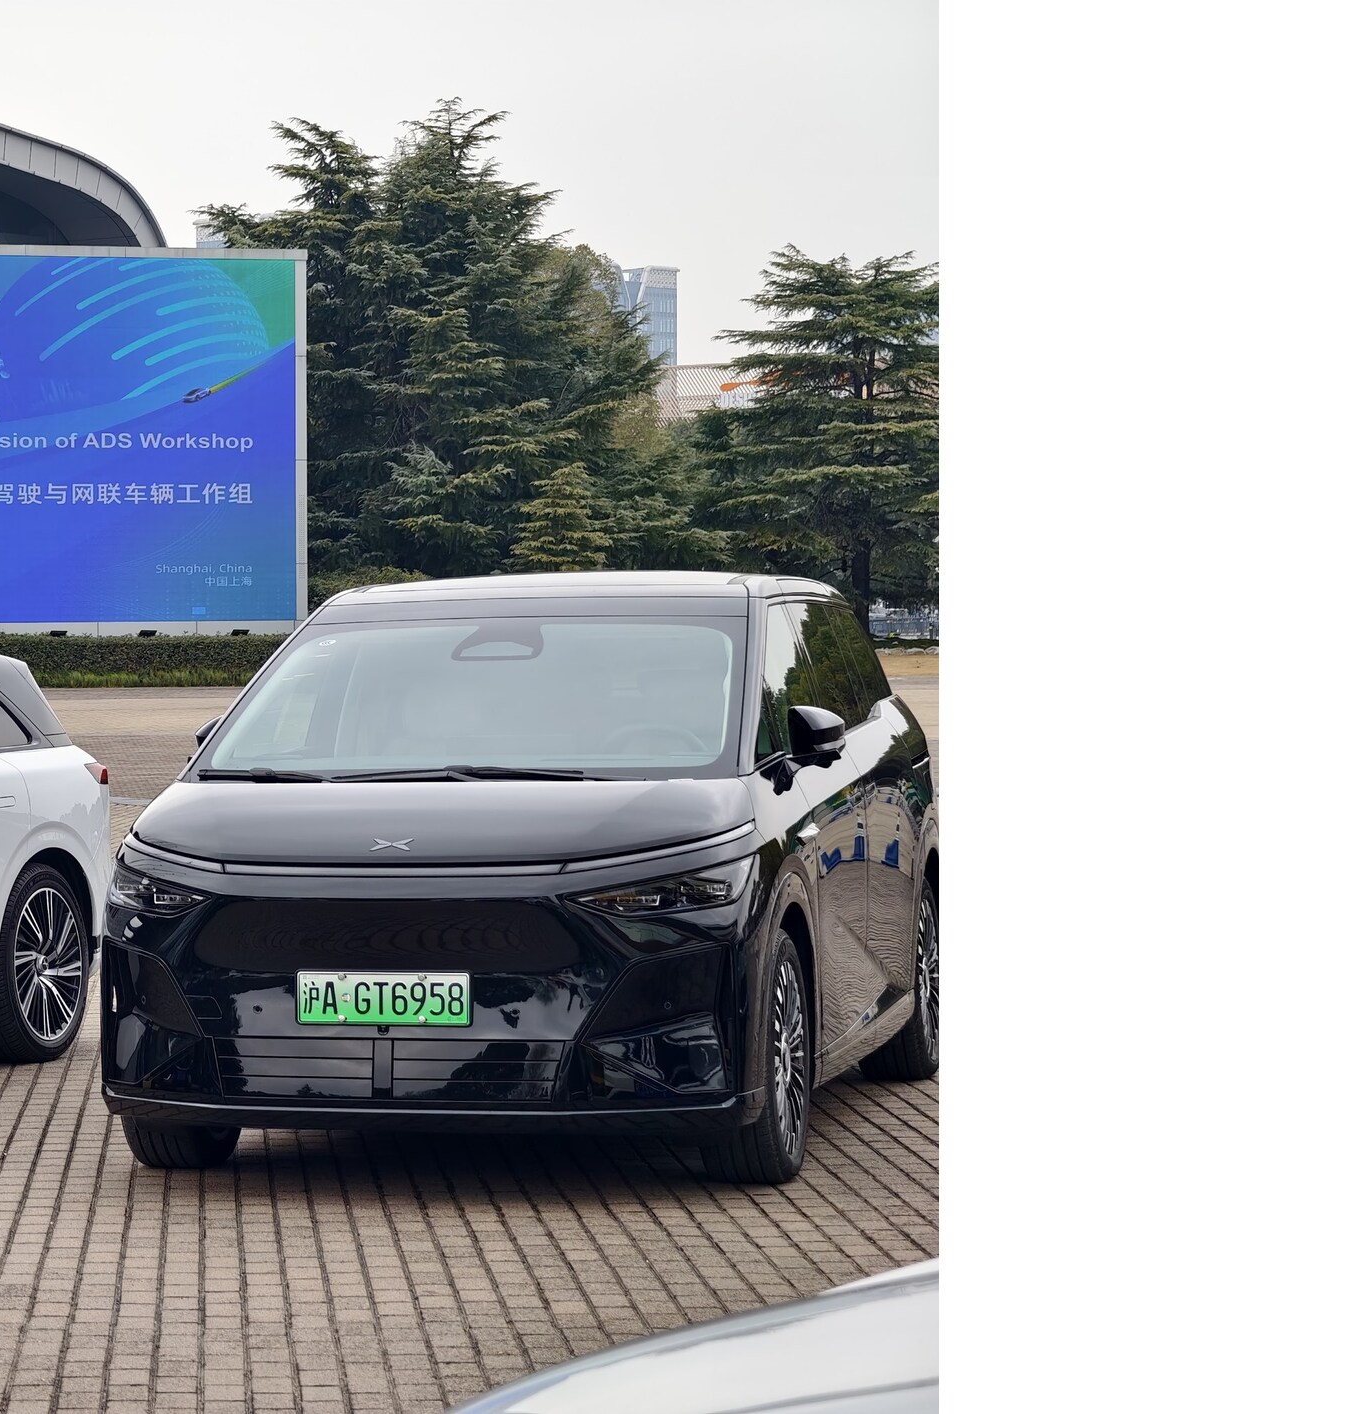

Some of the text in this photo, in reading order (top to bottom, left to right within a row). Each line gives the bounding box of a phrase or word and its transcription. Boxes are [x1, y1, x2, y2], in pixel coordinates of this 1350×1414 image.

[54, 431, 79, 449] of
[82, 432, 133, 449] ADS
[139, 432, 254, 453] Workshop
[155, 563, 253, 576] Shanghai, China
[204, 575, 253, 587] 中国上海
[354, 981, 465, 1017] GT6958
